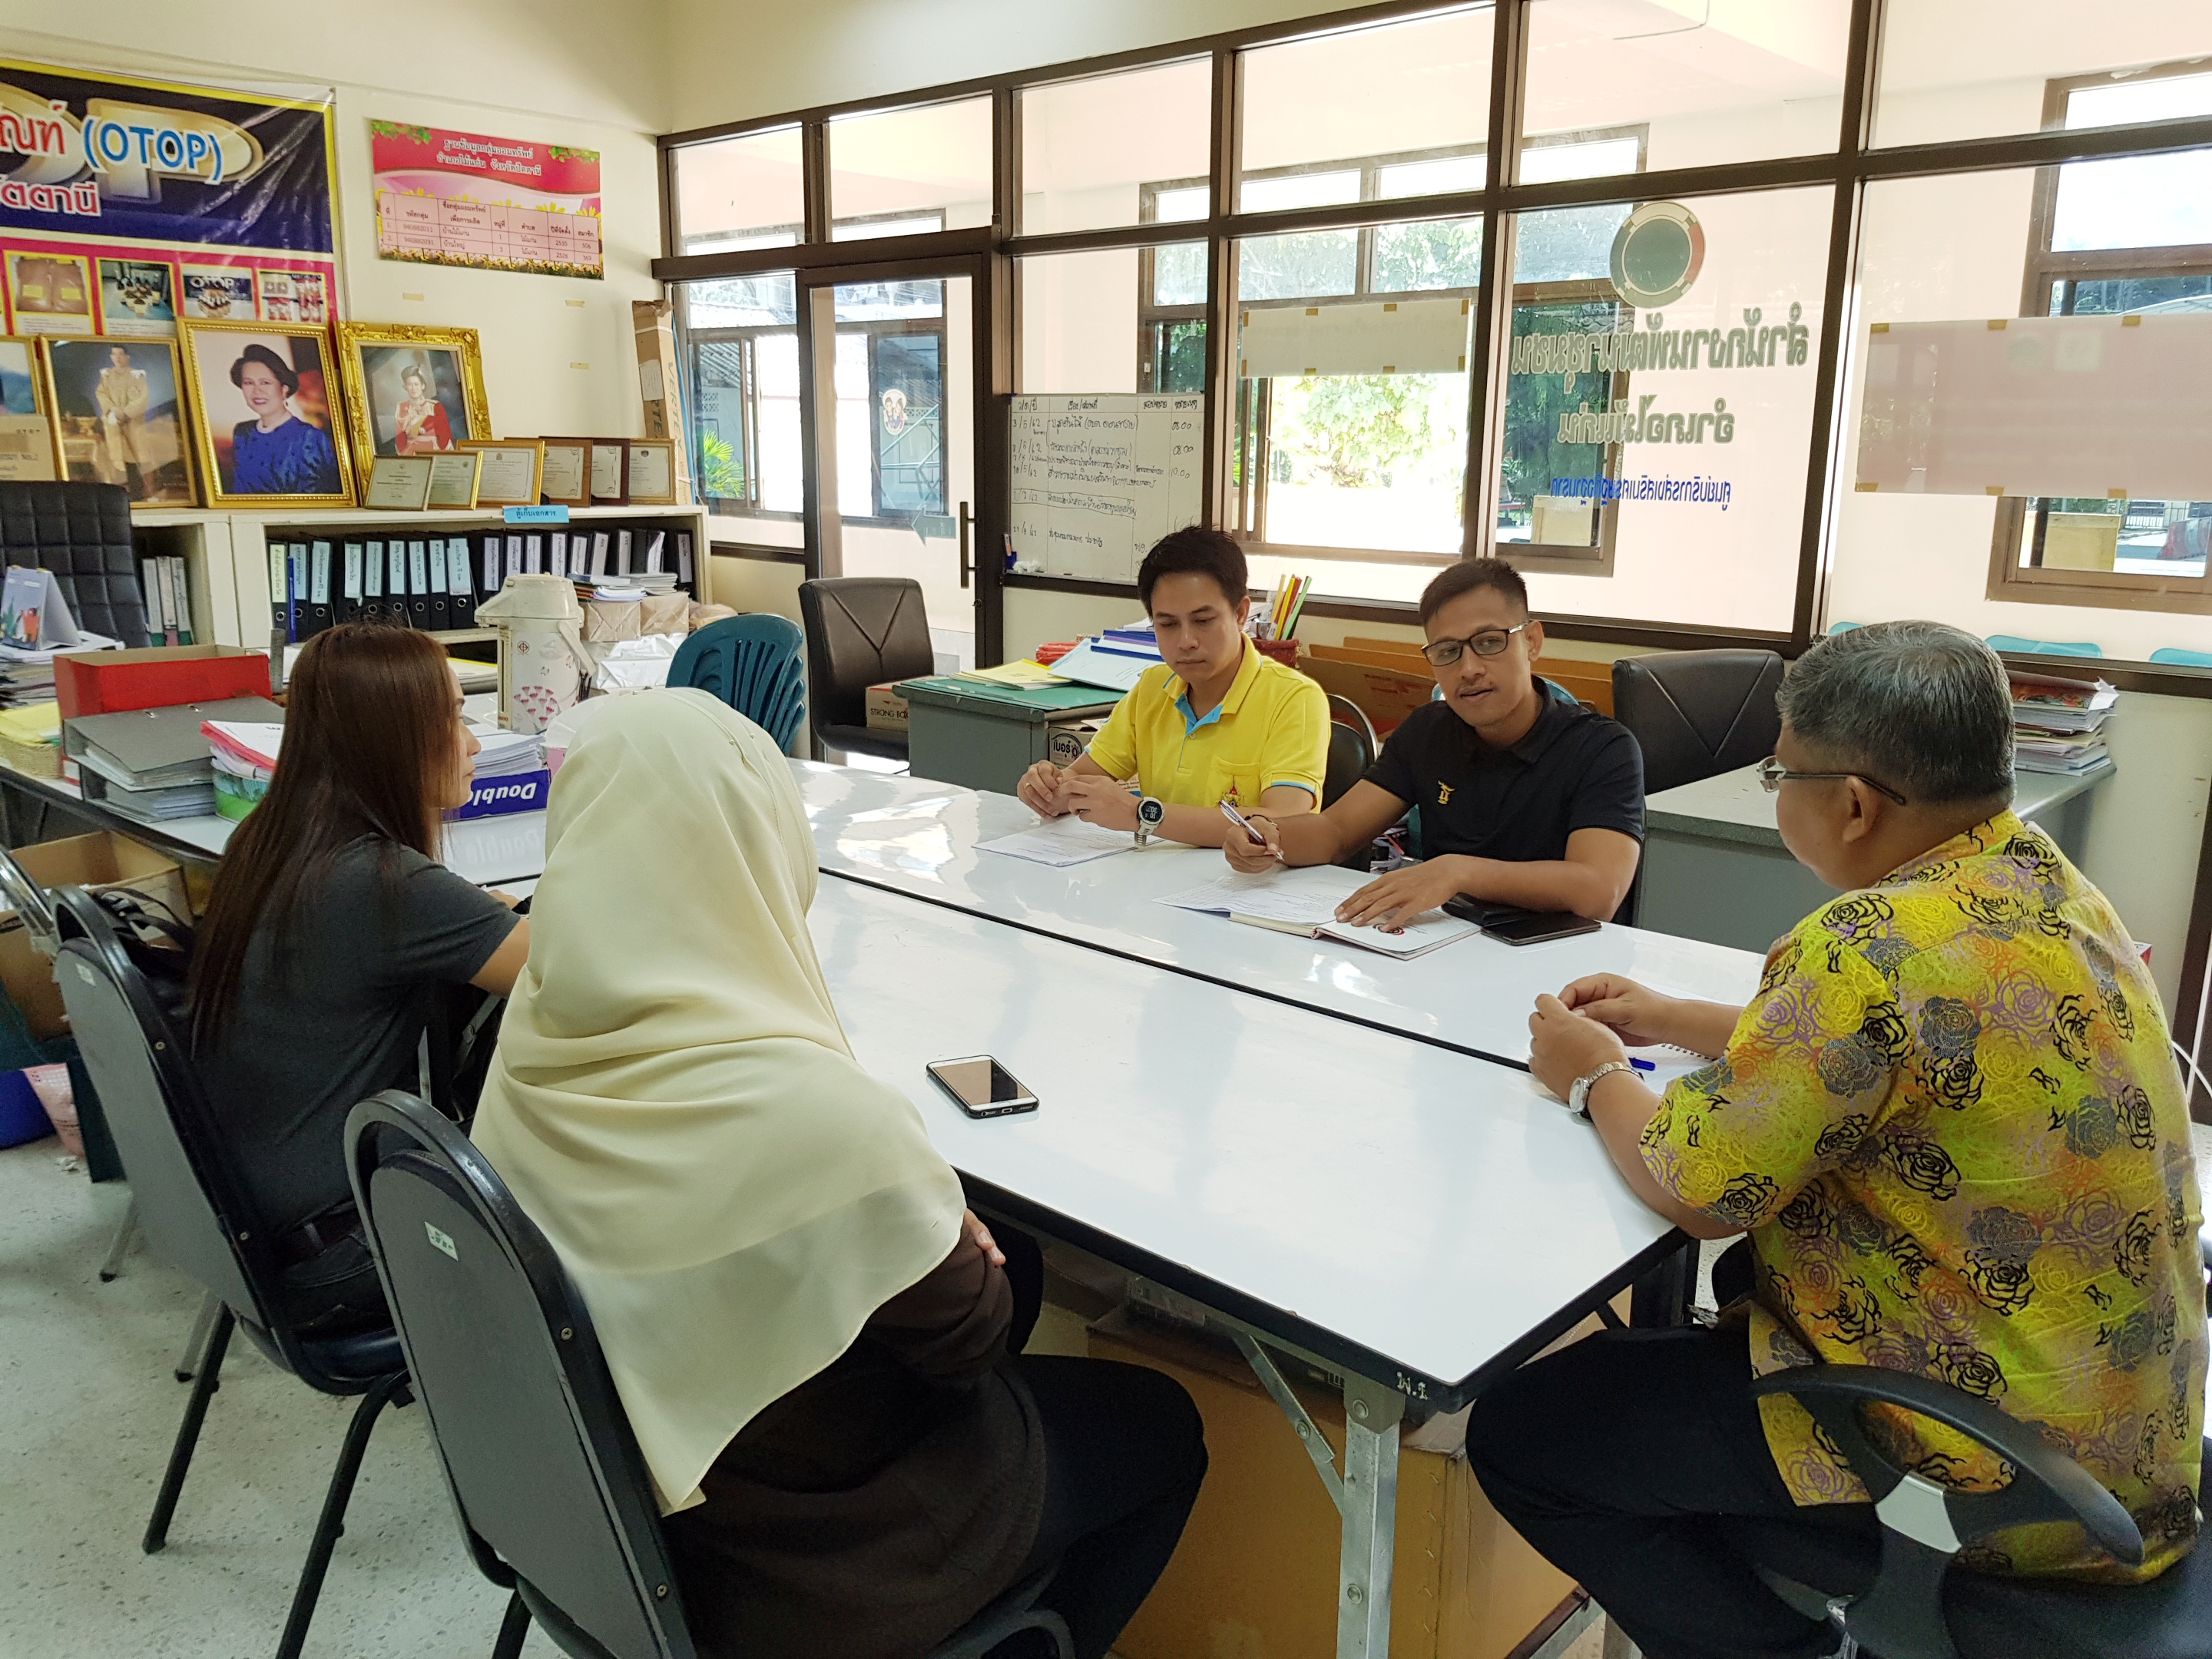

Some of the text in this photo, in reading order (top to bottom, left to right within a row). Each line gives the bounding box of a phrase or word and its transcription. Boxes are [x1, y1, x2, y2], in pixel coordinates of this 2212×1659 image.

[84, 118, 222, 180] (OTOP)
[444, 137, 533, 159] ฐานข้อมูลกลุ่มออมทรัพย์
[438, 152, 541, 176] อำเภอไม้แก่น จังหวัดปัตตานี
[0, 176, 100, 215] ตตานี
[515, 508, 556, 519] ตู้เก็บเอกสาร
[870, 707, 895, 717] STRONG
